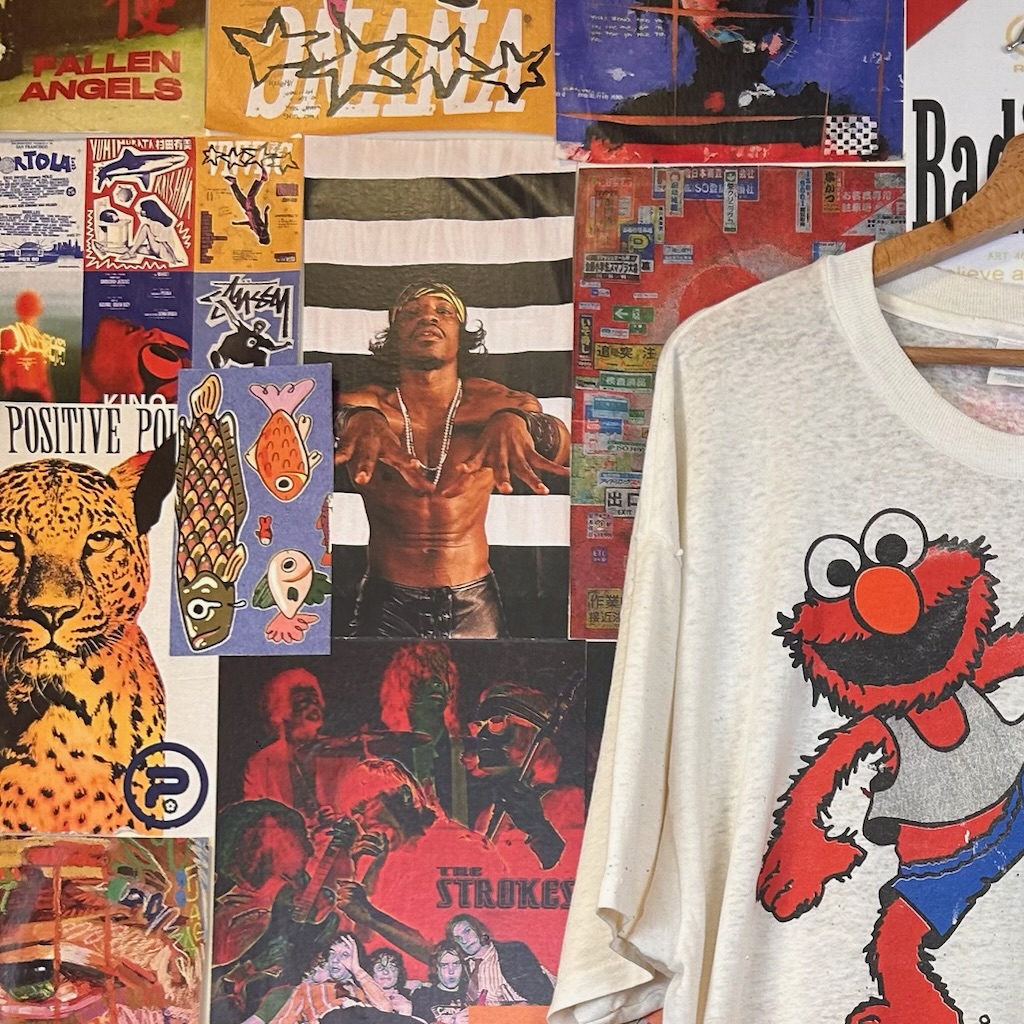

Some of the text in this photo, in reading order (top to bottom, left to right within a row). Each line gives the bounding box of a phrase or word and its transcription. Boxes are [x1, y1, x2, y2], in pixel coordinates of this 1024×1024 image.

[33, 50, 181, 77] FALLEN
[19, 76, 183, 101] ANGELS
[0, 151, 72, 173] RTOLA
[5, 405, 121, 454] POSITIVE
[589, 594, 622, 609] 作業
[436, 866, 483, 876] THE
[436, 878, 576, 909] STROKES
